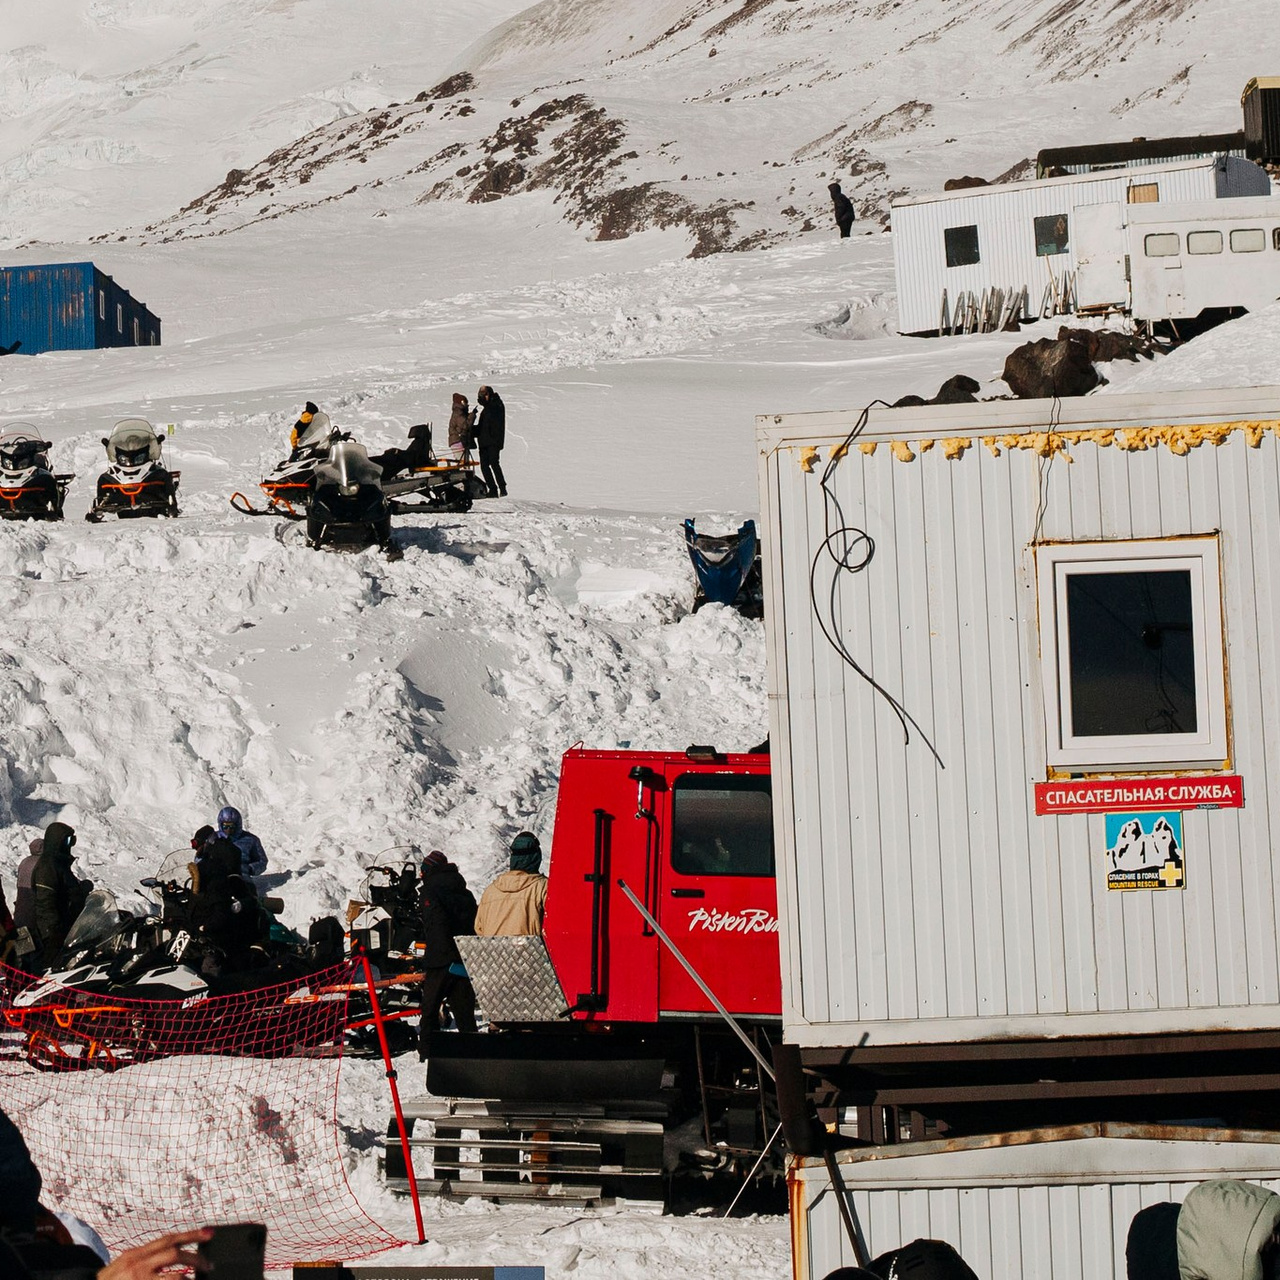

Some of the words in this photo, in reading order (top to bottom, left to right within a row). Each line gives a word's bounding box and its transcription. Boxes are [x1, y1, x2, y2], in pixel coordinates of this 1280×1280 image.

[1046, 788, 1164, 804] СПАСАТЕЛЬНАЯ
[1168, 785, 1232, 800] СЛУЖБА
[1141, 872, 1159, 880] ГОРАХ
[1137, 880, 1159, 888] RESCUE
[688, 908, 779, 934] PistenBu
